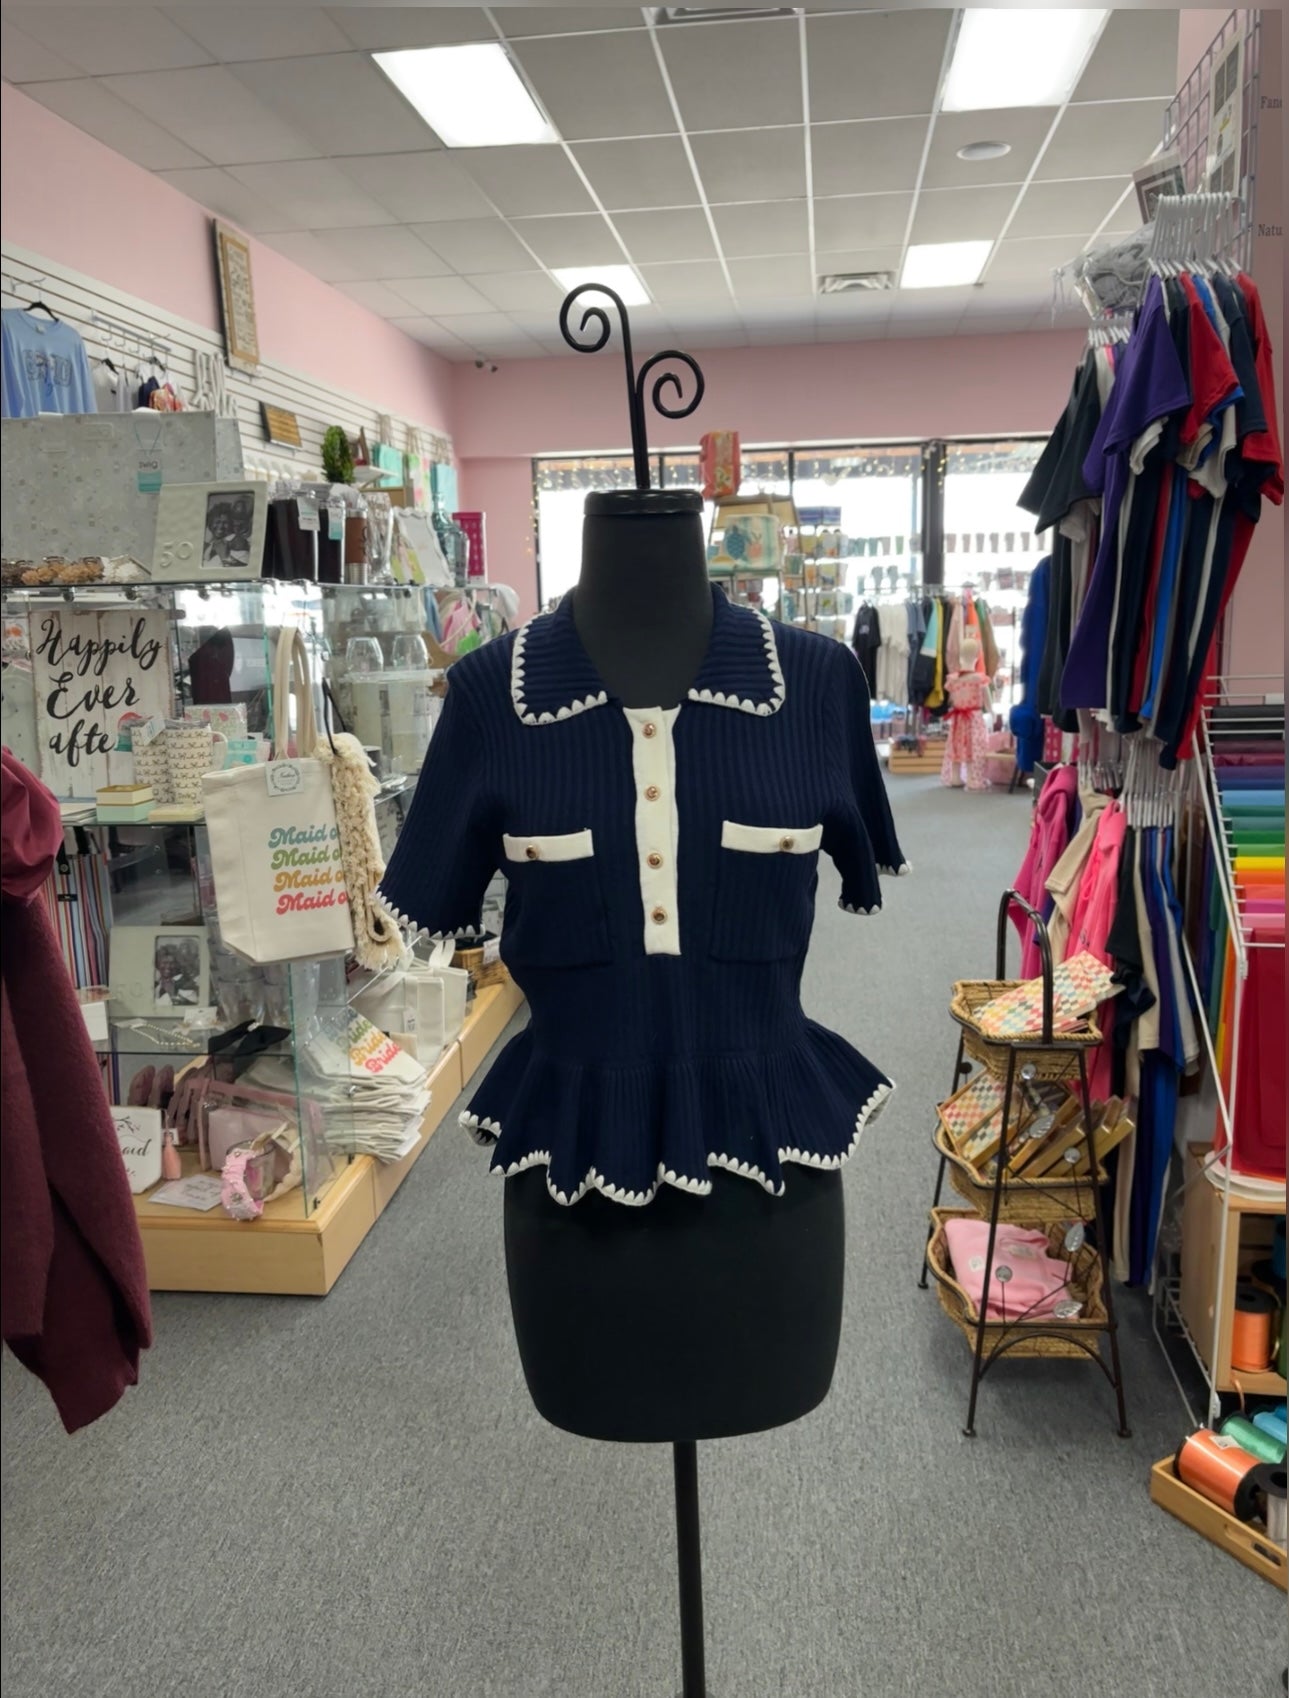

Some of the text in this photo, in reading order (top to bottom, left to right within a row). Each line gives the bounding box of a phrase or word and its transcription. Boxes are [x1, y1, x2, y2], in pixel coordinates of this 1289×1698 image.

[1257, 223, 1282, 236] Natu
[160, 541, 193, 568] 50
[36, 617, 163, 676] Happily
[46, 671, 140, 720] Ever
[48, 718, 116, 768] afte
[268, 823, 340, 849] Maid o
[270, 844, 341, 871] Maid o
[273, 866, 345, 893] Maid o
[275, 888, 348, 916] Maid o
[121, 1138, 153, 1157] aid
